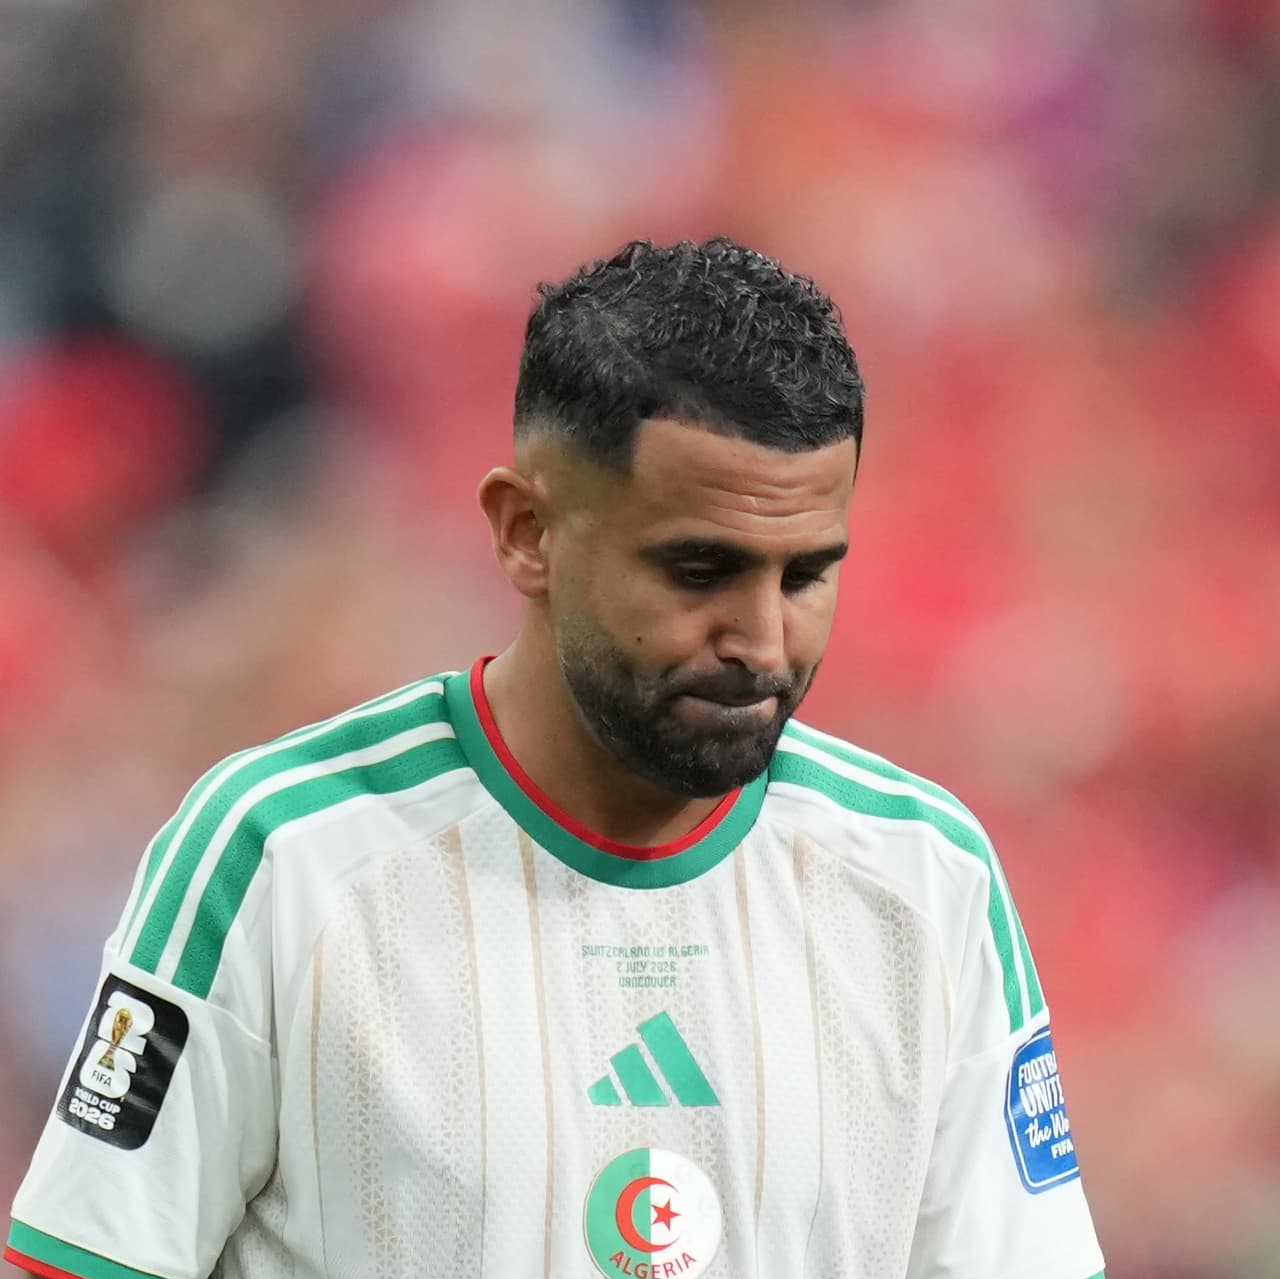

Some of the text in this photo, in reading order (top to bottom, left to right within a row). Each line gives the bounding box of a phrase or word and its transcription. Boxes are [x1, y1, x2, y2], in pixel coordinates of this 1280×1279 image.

[582, 945, 650, 958] SWITZERLAND
[668, 944, 710, 957] ALGERIA
[626, 961, 647, 973] JULY
[651, 961, 678, 973] 2026
[619, 976, 677, 988] VANCOUVER
[1018, 1050, 1058, 1087] FOOTB
[91, 1069, 112, 1087] FIFA
[69, 1097, 116, 1130] 2026
[99, 1100, 121, 1114] CUP
[1024, 1118, 1052, 1148] the
[1051, 1138, 1075, 1159] FIFA
